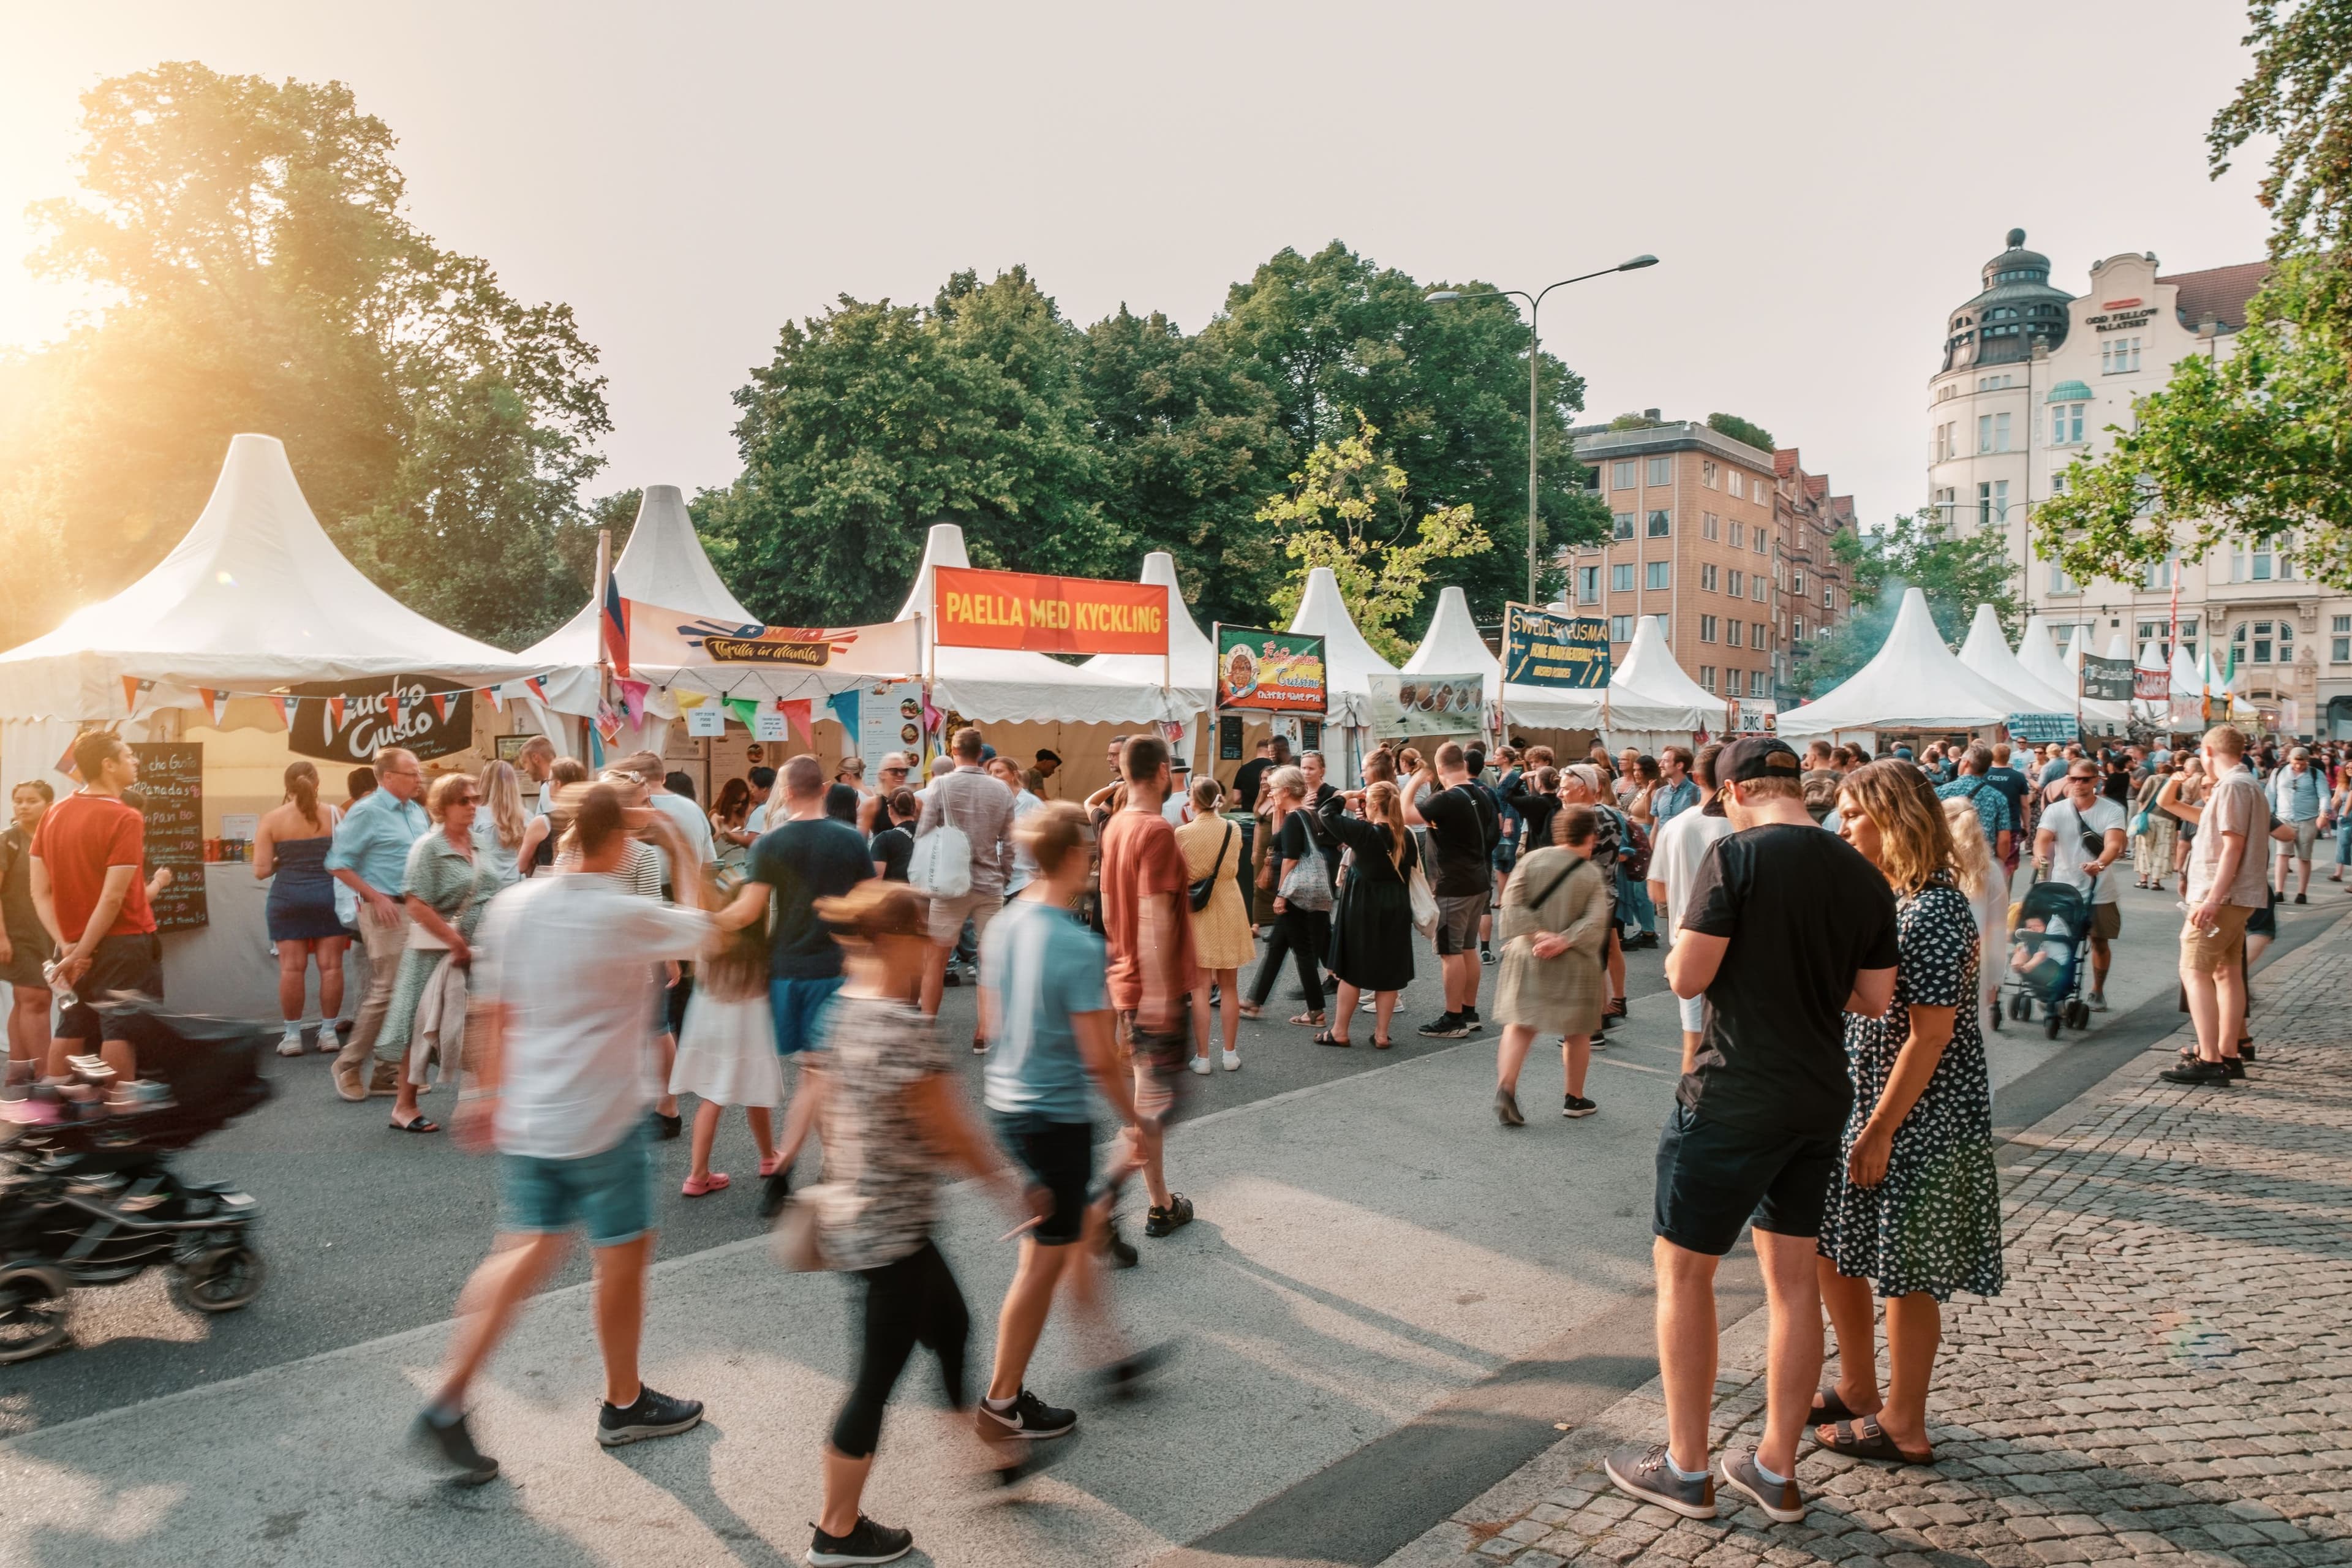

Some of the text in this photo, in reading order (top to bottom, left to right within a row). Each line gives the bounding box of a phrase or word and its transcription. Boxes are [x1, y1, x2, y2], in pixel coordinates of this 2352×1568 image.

[2085, 307, 2158, 325] ODD FELLOW
[2096, 318, 2149, 332] PALATSET
[946, 592, 1161, 634] PAELLA MED KYCKLING
[1511, 614, 1564, 639] SWEDISH
[709, 640, 820, 663] Thrilla in Manila
[1276, 668, 1321, 689] Cuisine
[1744, 715, 1760, 731] DRC
[349, 712, 433, 762] Gusto
